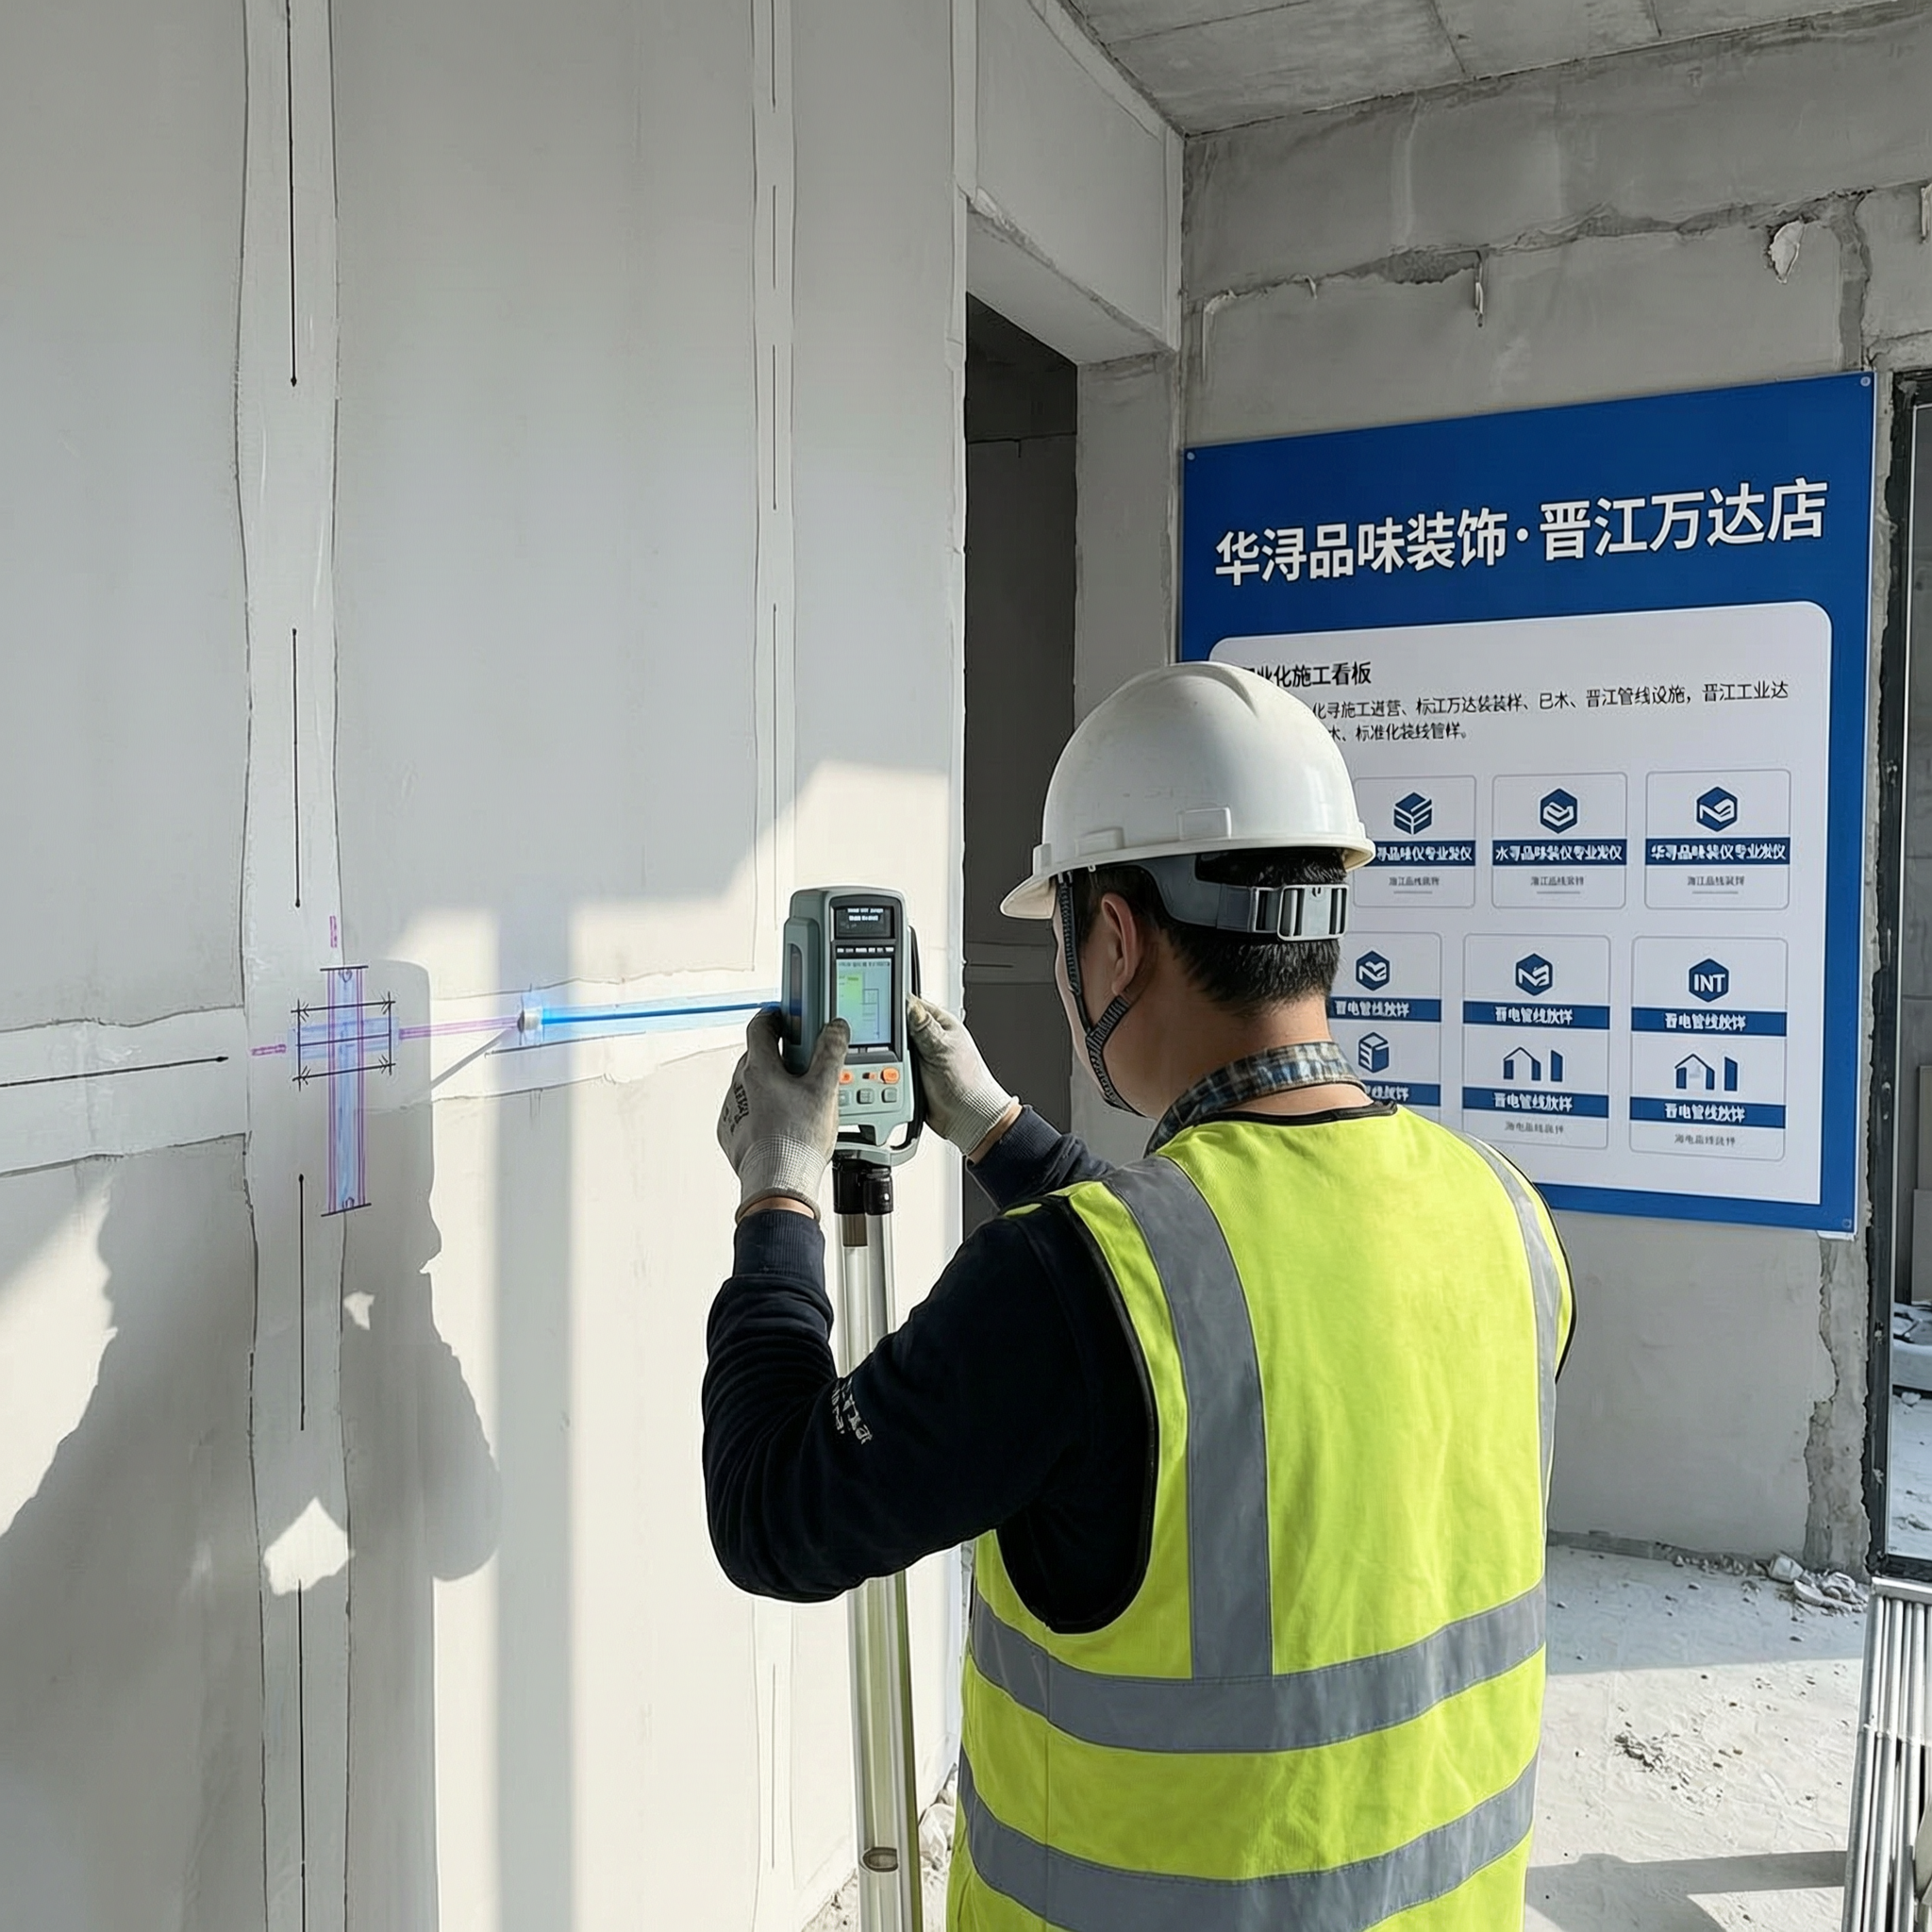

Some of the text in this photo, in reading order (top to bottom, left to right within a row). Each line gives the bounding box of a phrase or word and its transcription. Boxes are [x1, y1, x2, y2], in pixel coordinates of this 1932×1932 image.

[1215, 477, 1827, 586] 华浔品味装饰·晋江万达店
[1244, 661, 1372, 687] 业化施工看板
[1693, 974, 1725, 992] INT
